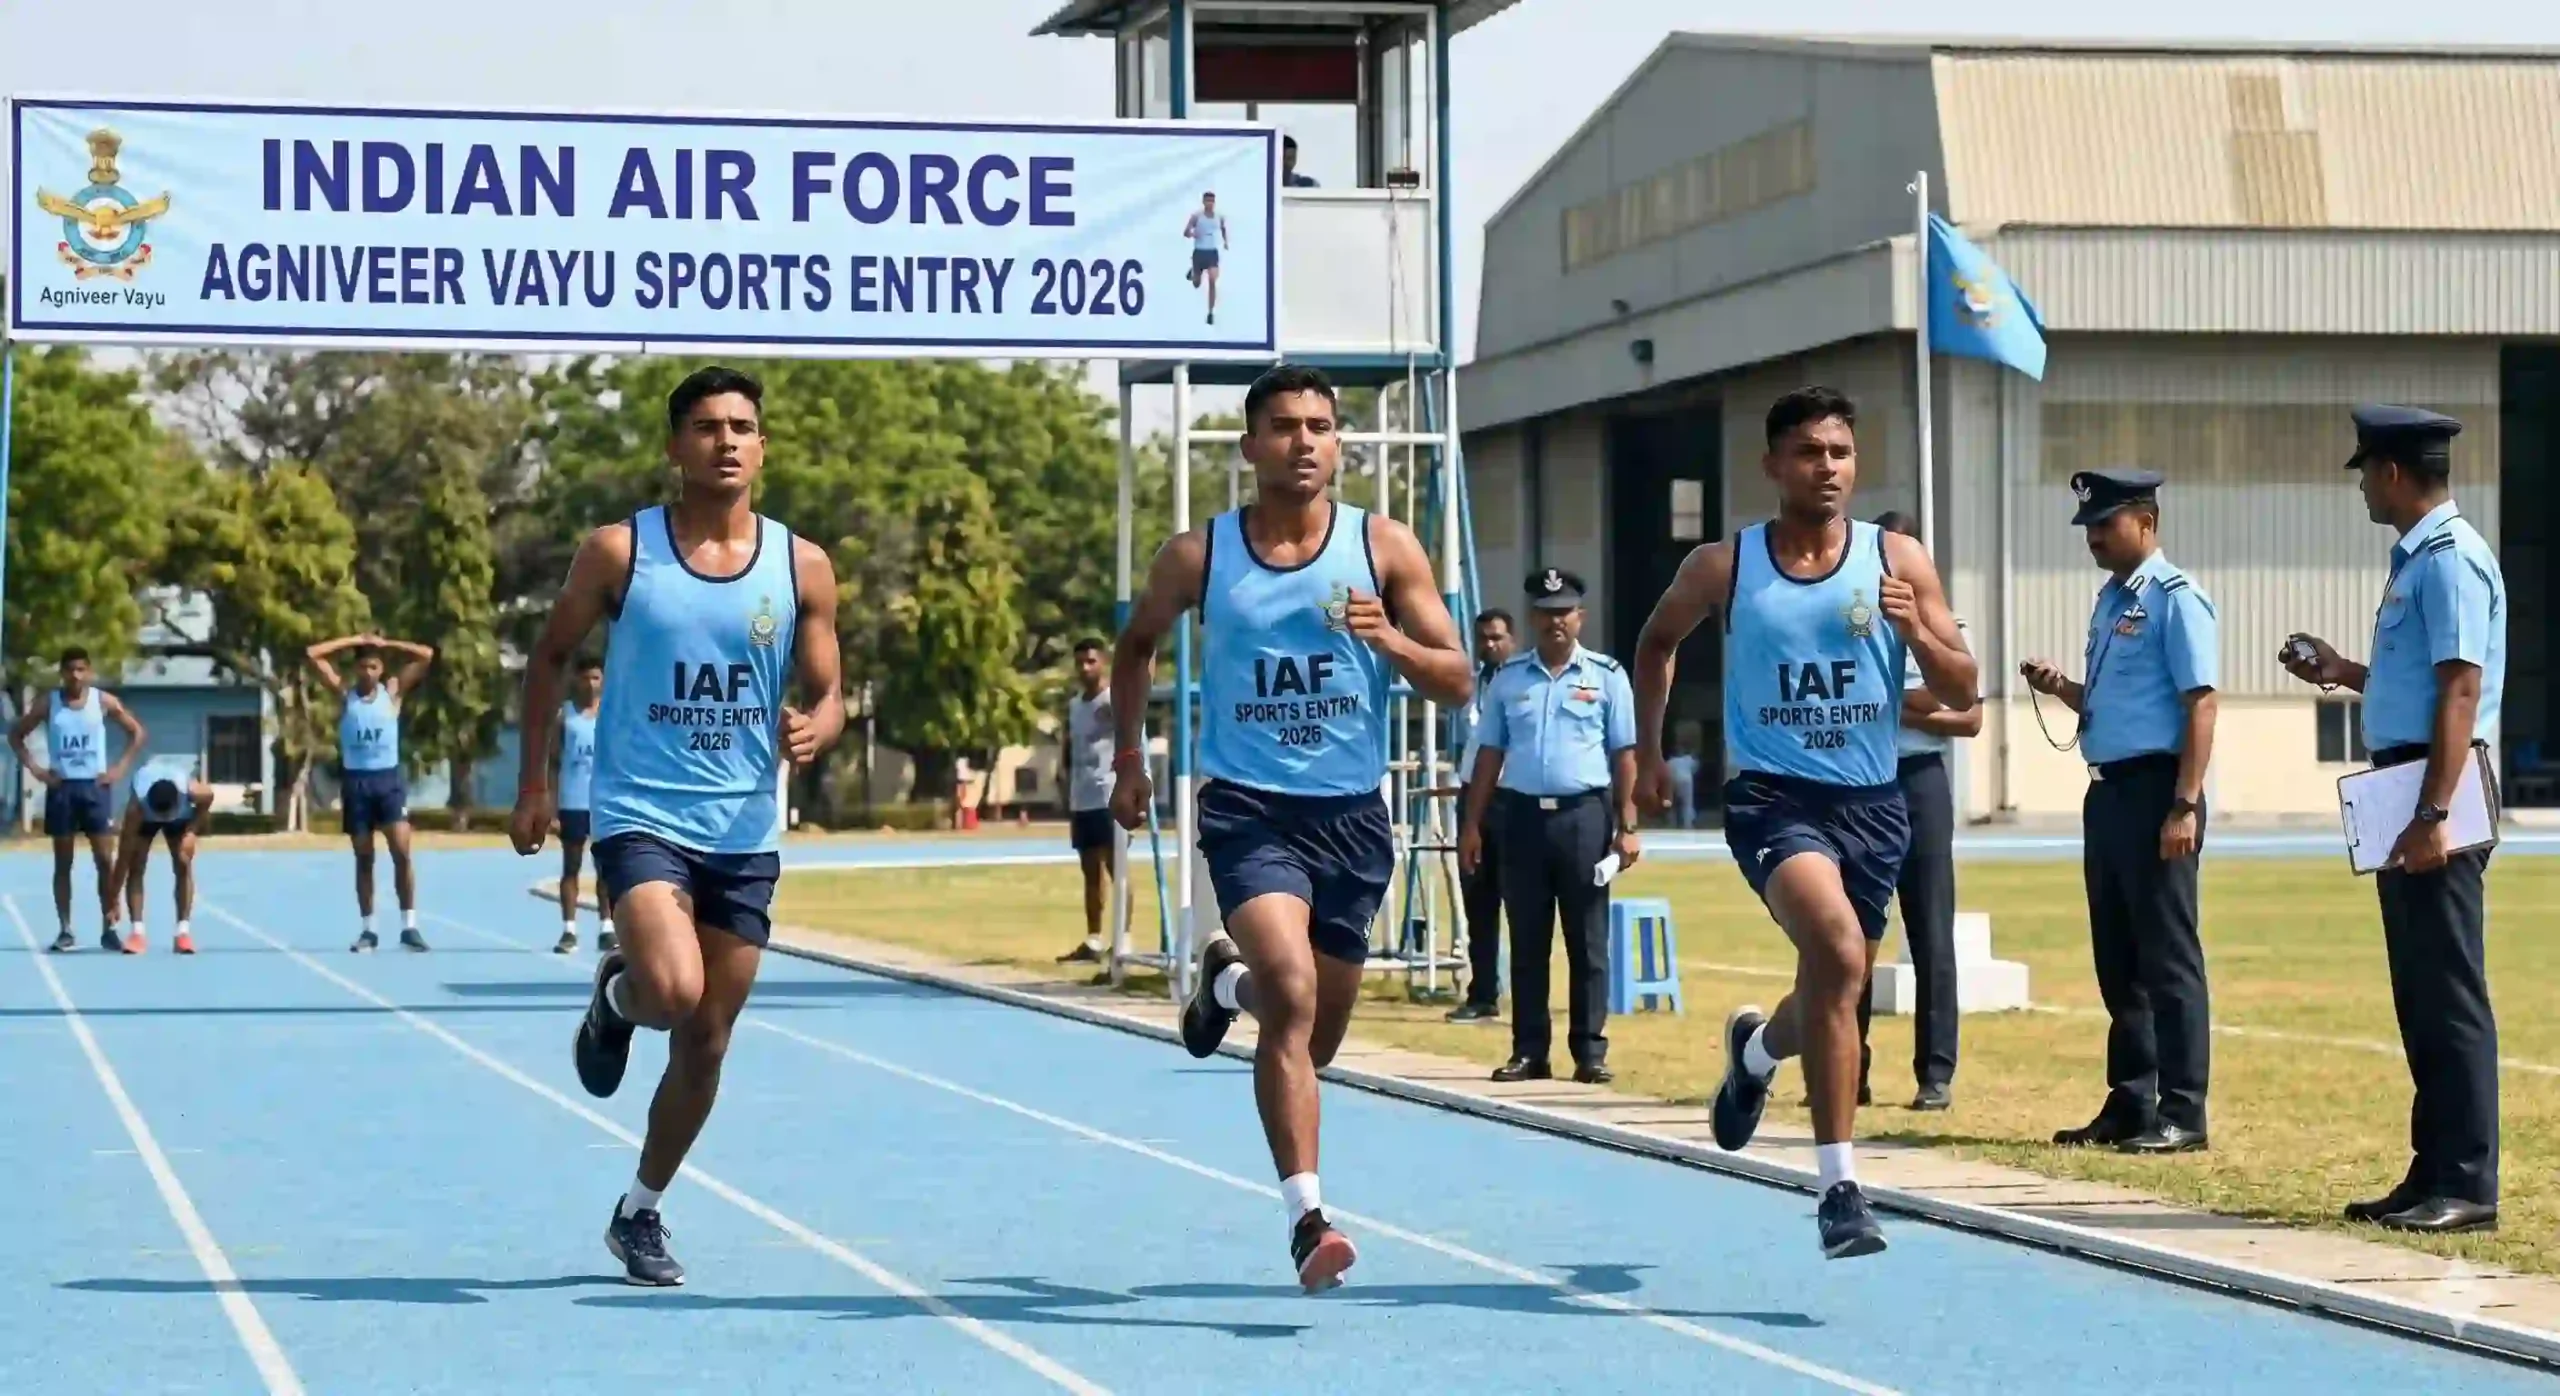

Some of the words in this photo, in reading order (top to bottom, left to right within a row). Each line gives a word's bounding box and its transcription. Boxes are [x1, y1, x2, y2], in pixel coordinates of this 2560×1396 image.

[263, 138, 575, 217] INDIAN
[607, 147, 760, 221] AIR
[792, 151, 1075, 227] FORCE
[199, 242, 466, 305] AGNIVEER
[481, 248, 615, 308] VAYU
[635, 250, 832, 312] SPORTS
[850, 255, 1015, 314] ENTRY
[1030, 258, 1145, 316] 2026
[40, 286, 118, 308] Agniveer
[123, 288, 165, 310] Vayu
[674, 661, 754, 703] IAF
[1254, 652, 1334, 698] IAF
[1777, 660, 1856, 703] IAF
[648, 703, 716, 726] SPORTS
[721, 706, 768, 728] ENTRY
[1234, 702, 1301, 724] SPORTS
[1304, 694, 1360, 720] ENTRY
[1758, 706, 1825, 727] SPORTS
[1830, 702, 1880, 725] ENTRY
[63, 734, 90, 750] IAF
[356, 727, 384, 743] IAF
[689, 731, 732, 751] 2026
[1277, 724, 1322, 747] 2026
[1802, 730, 1846, 750] 2026
